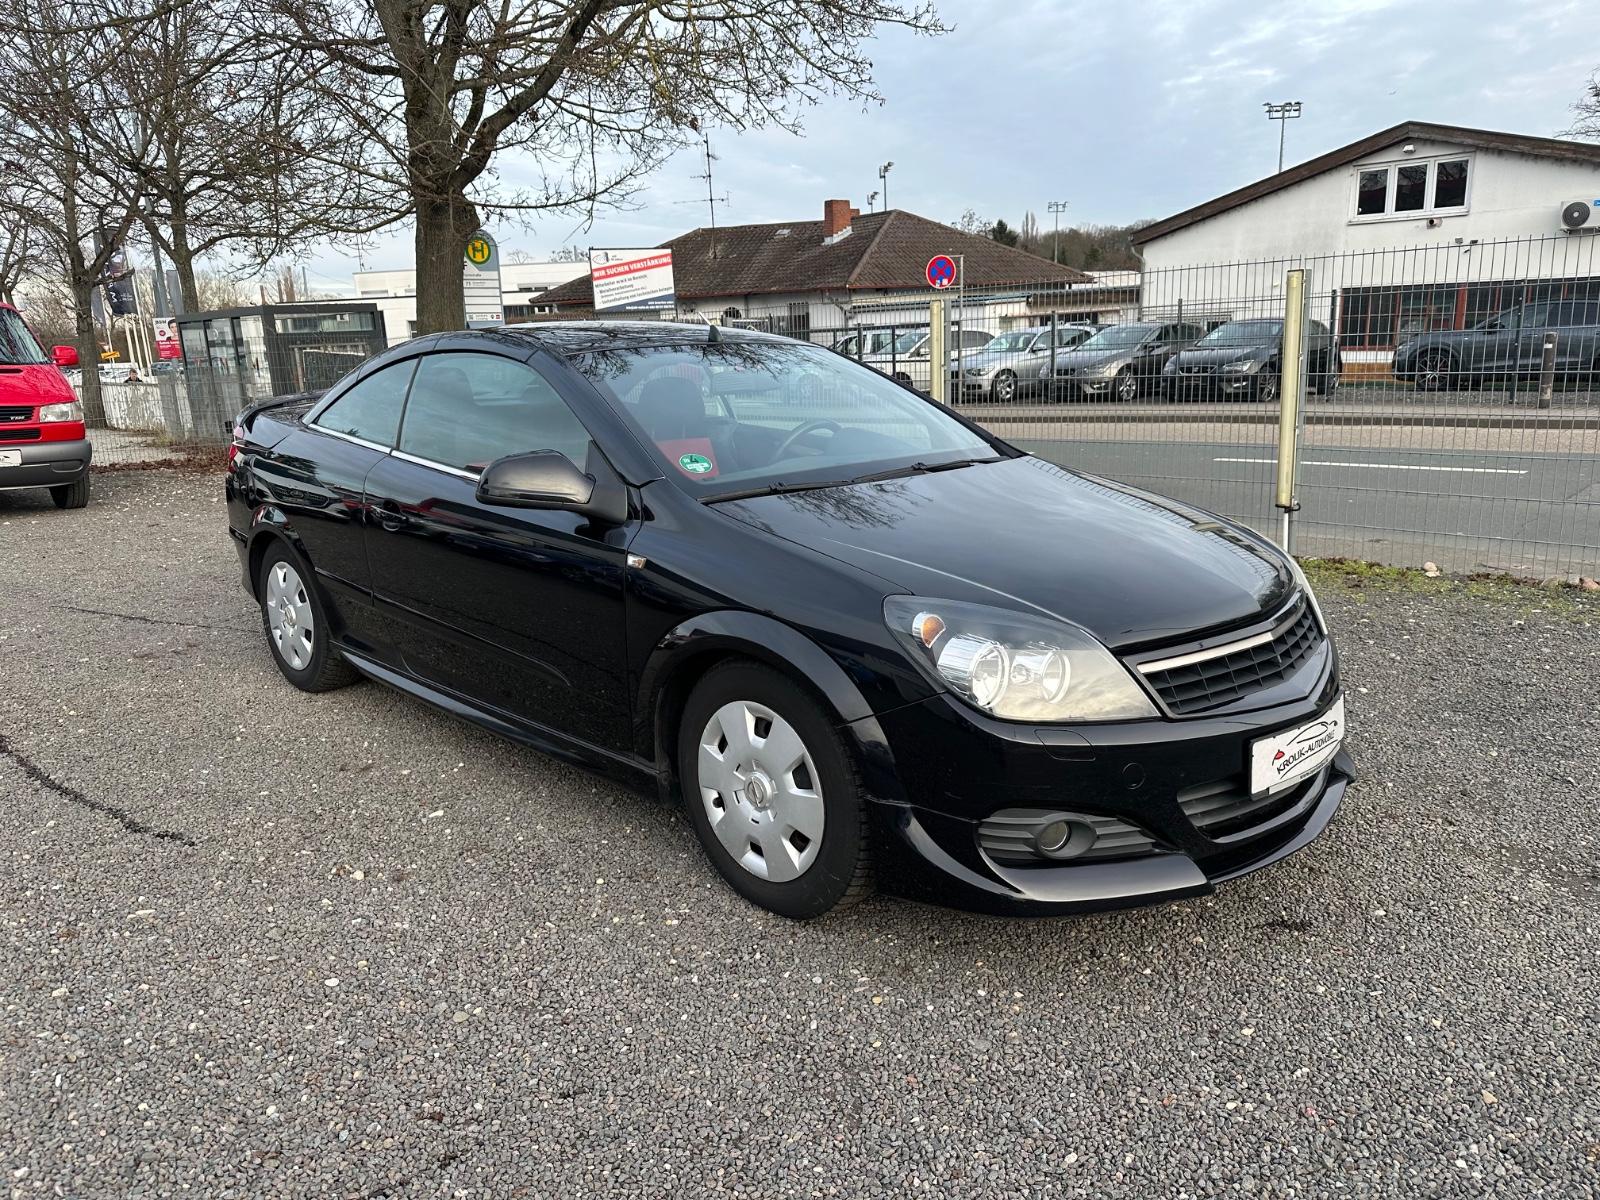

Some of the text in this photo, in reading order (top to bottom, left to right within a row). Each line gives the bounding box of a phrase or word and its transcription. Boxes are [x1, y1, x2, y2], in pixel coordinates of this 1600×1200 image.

[471, 241, 485, 259] H
[593, 270, 607, 278] WIR
[607, 264, 630, 275] SUCHEN
[630, 256, 672, 270] VERSTÄRKUNG
[690, 455, 699, 463] 4
